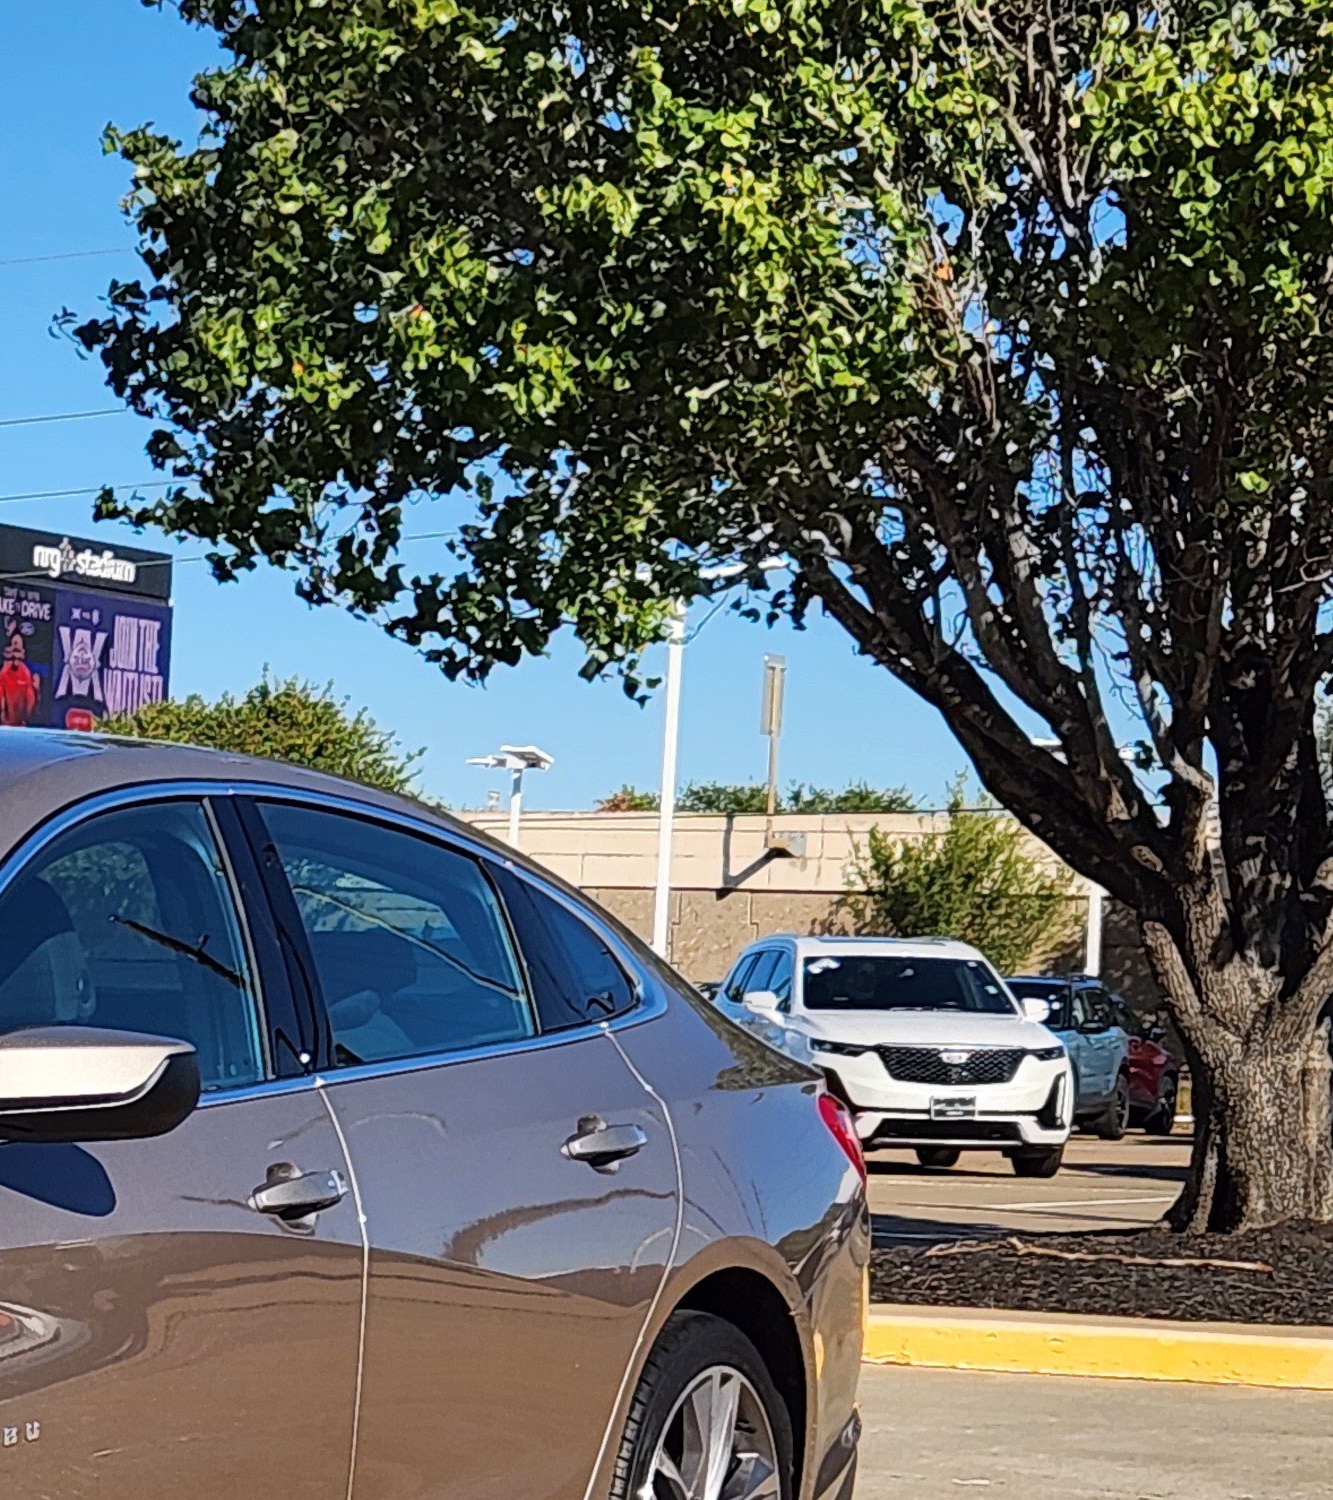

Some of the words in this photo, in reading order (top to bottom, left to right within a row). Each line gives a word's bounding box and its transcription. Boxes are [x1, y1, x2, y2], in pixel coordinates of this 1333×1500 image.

[33, 545, 62, 578] nrg
[76, 548, 137, 583] stadium
[21, 600, 51, 621] DRIVE
